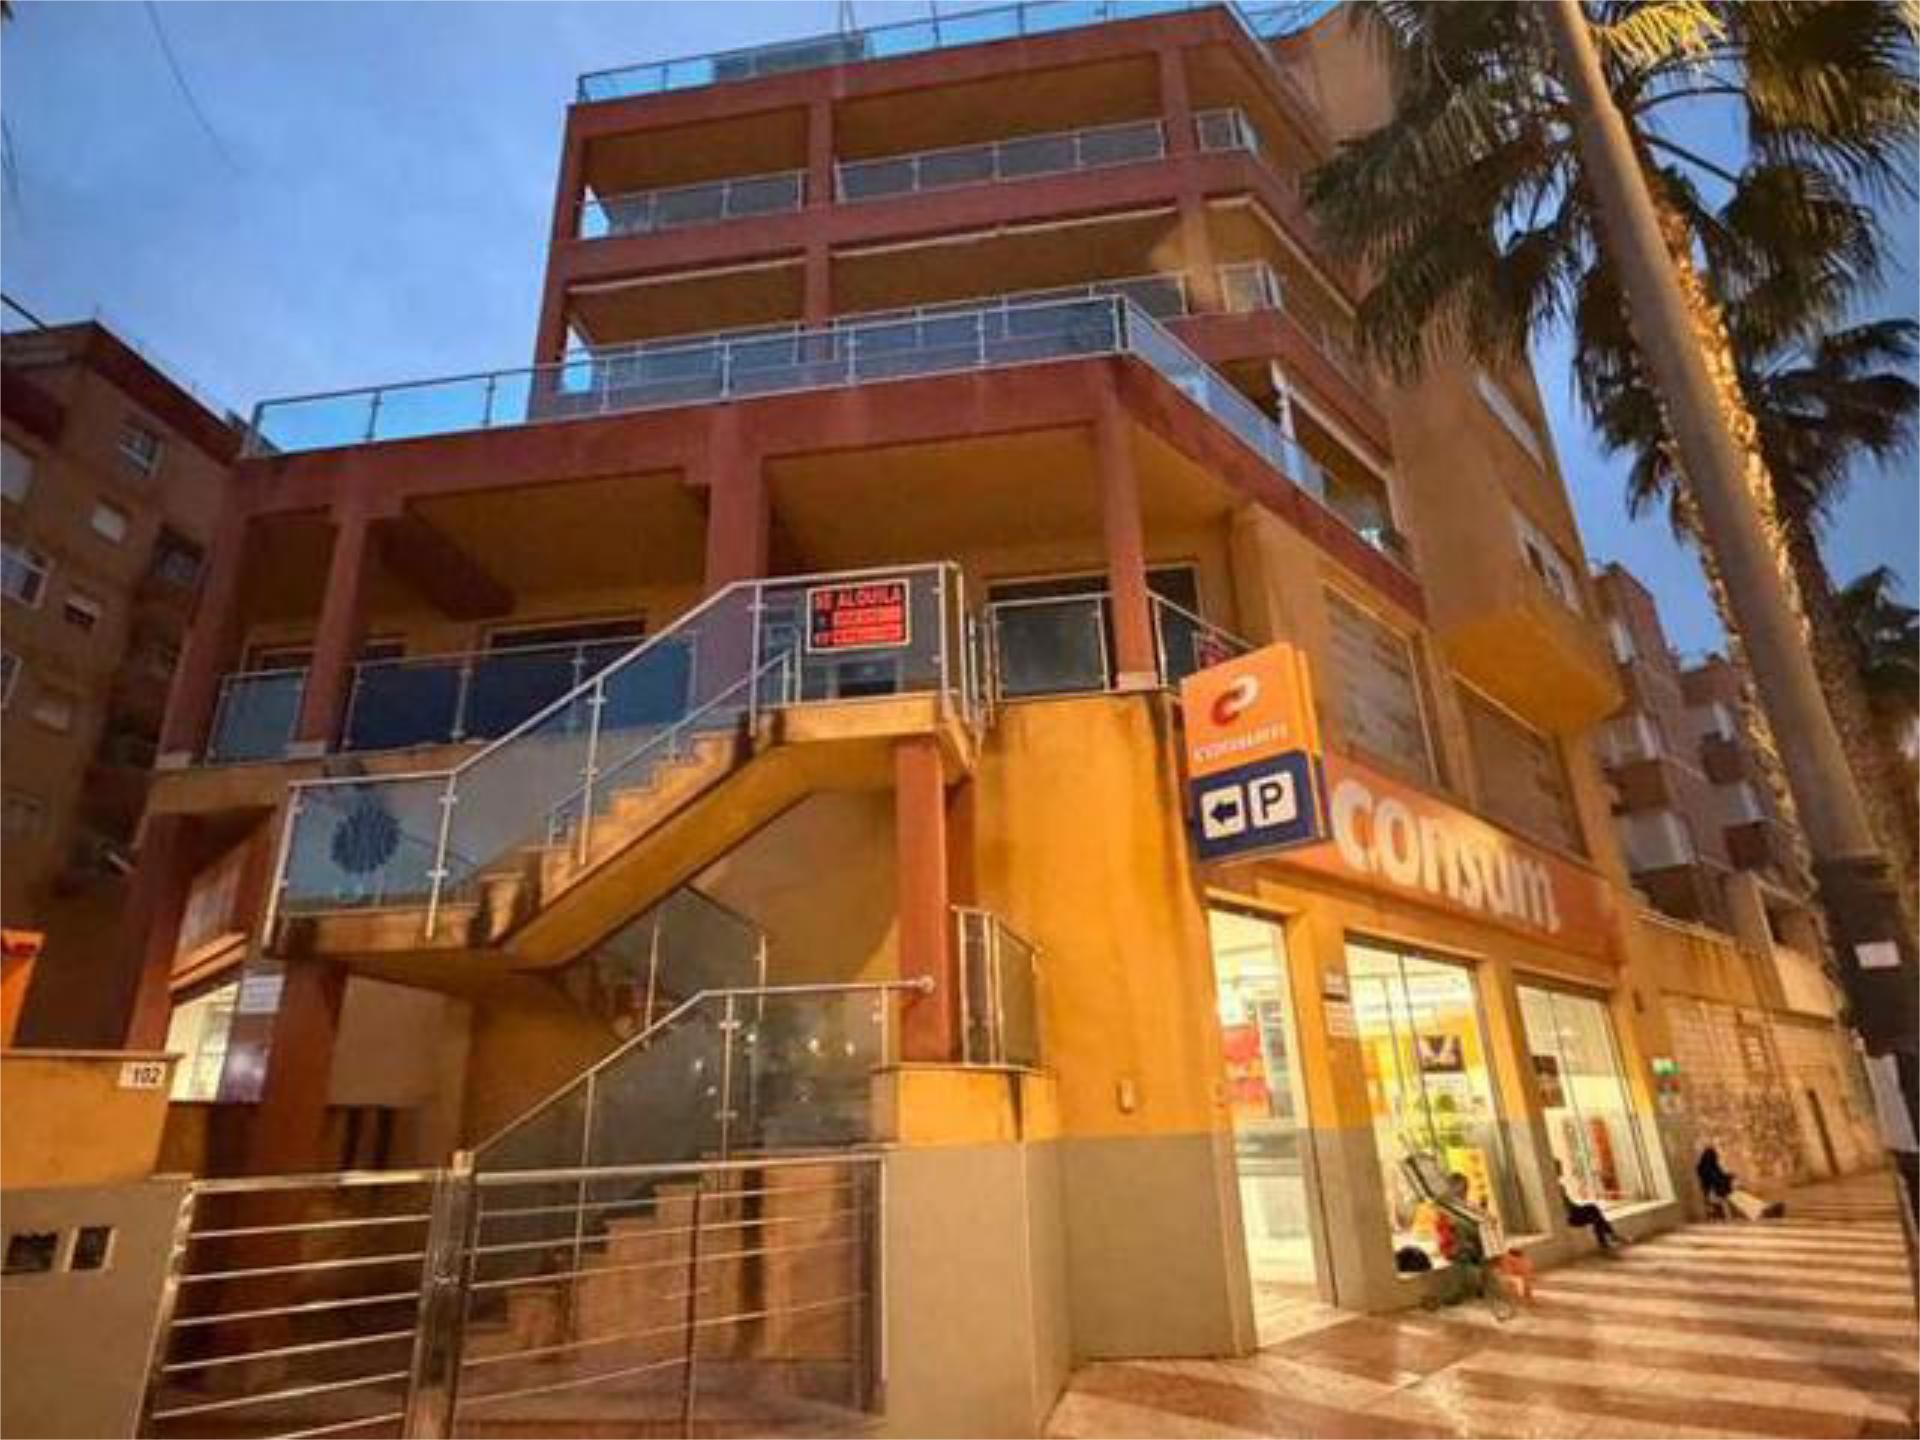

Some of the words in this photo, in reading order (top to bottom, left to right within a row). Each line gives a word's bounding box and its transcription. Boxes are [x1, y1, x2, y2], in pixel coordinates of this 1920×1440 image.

[1258, 782, 1283, 822] P
[1330, 778, 1560, 934] consum
[132, 1066, 163, 1085] 102
